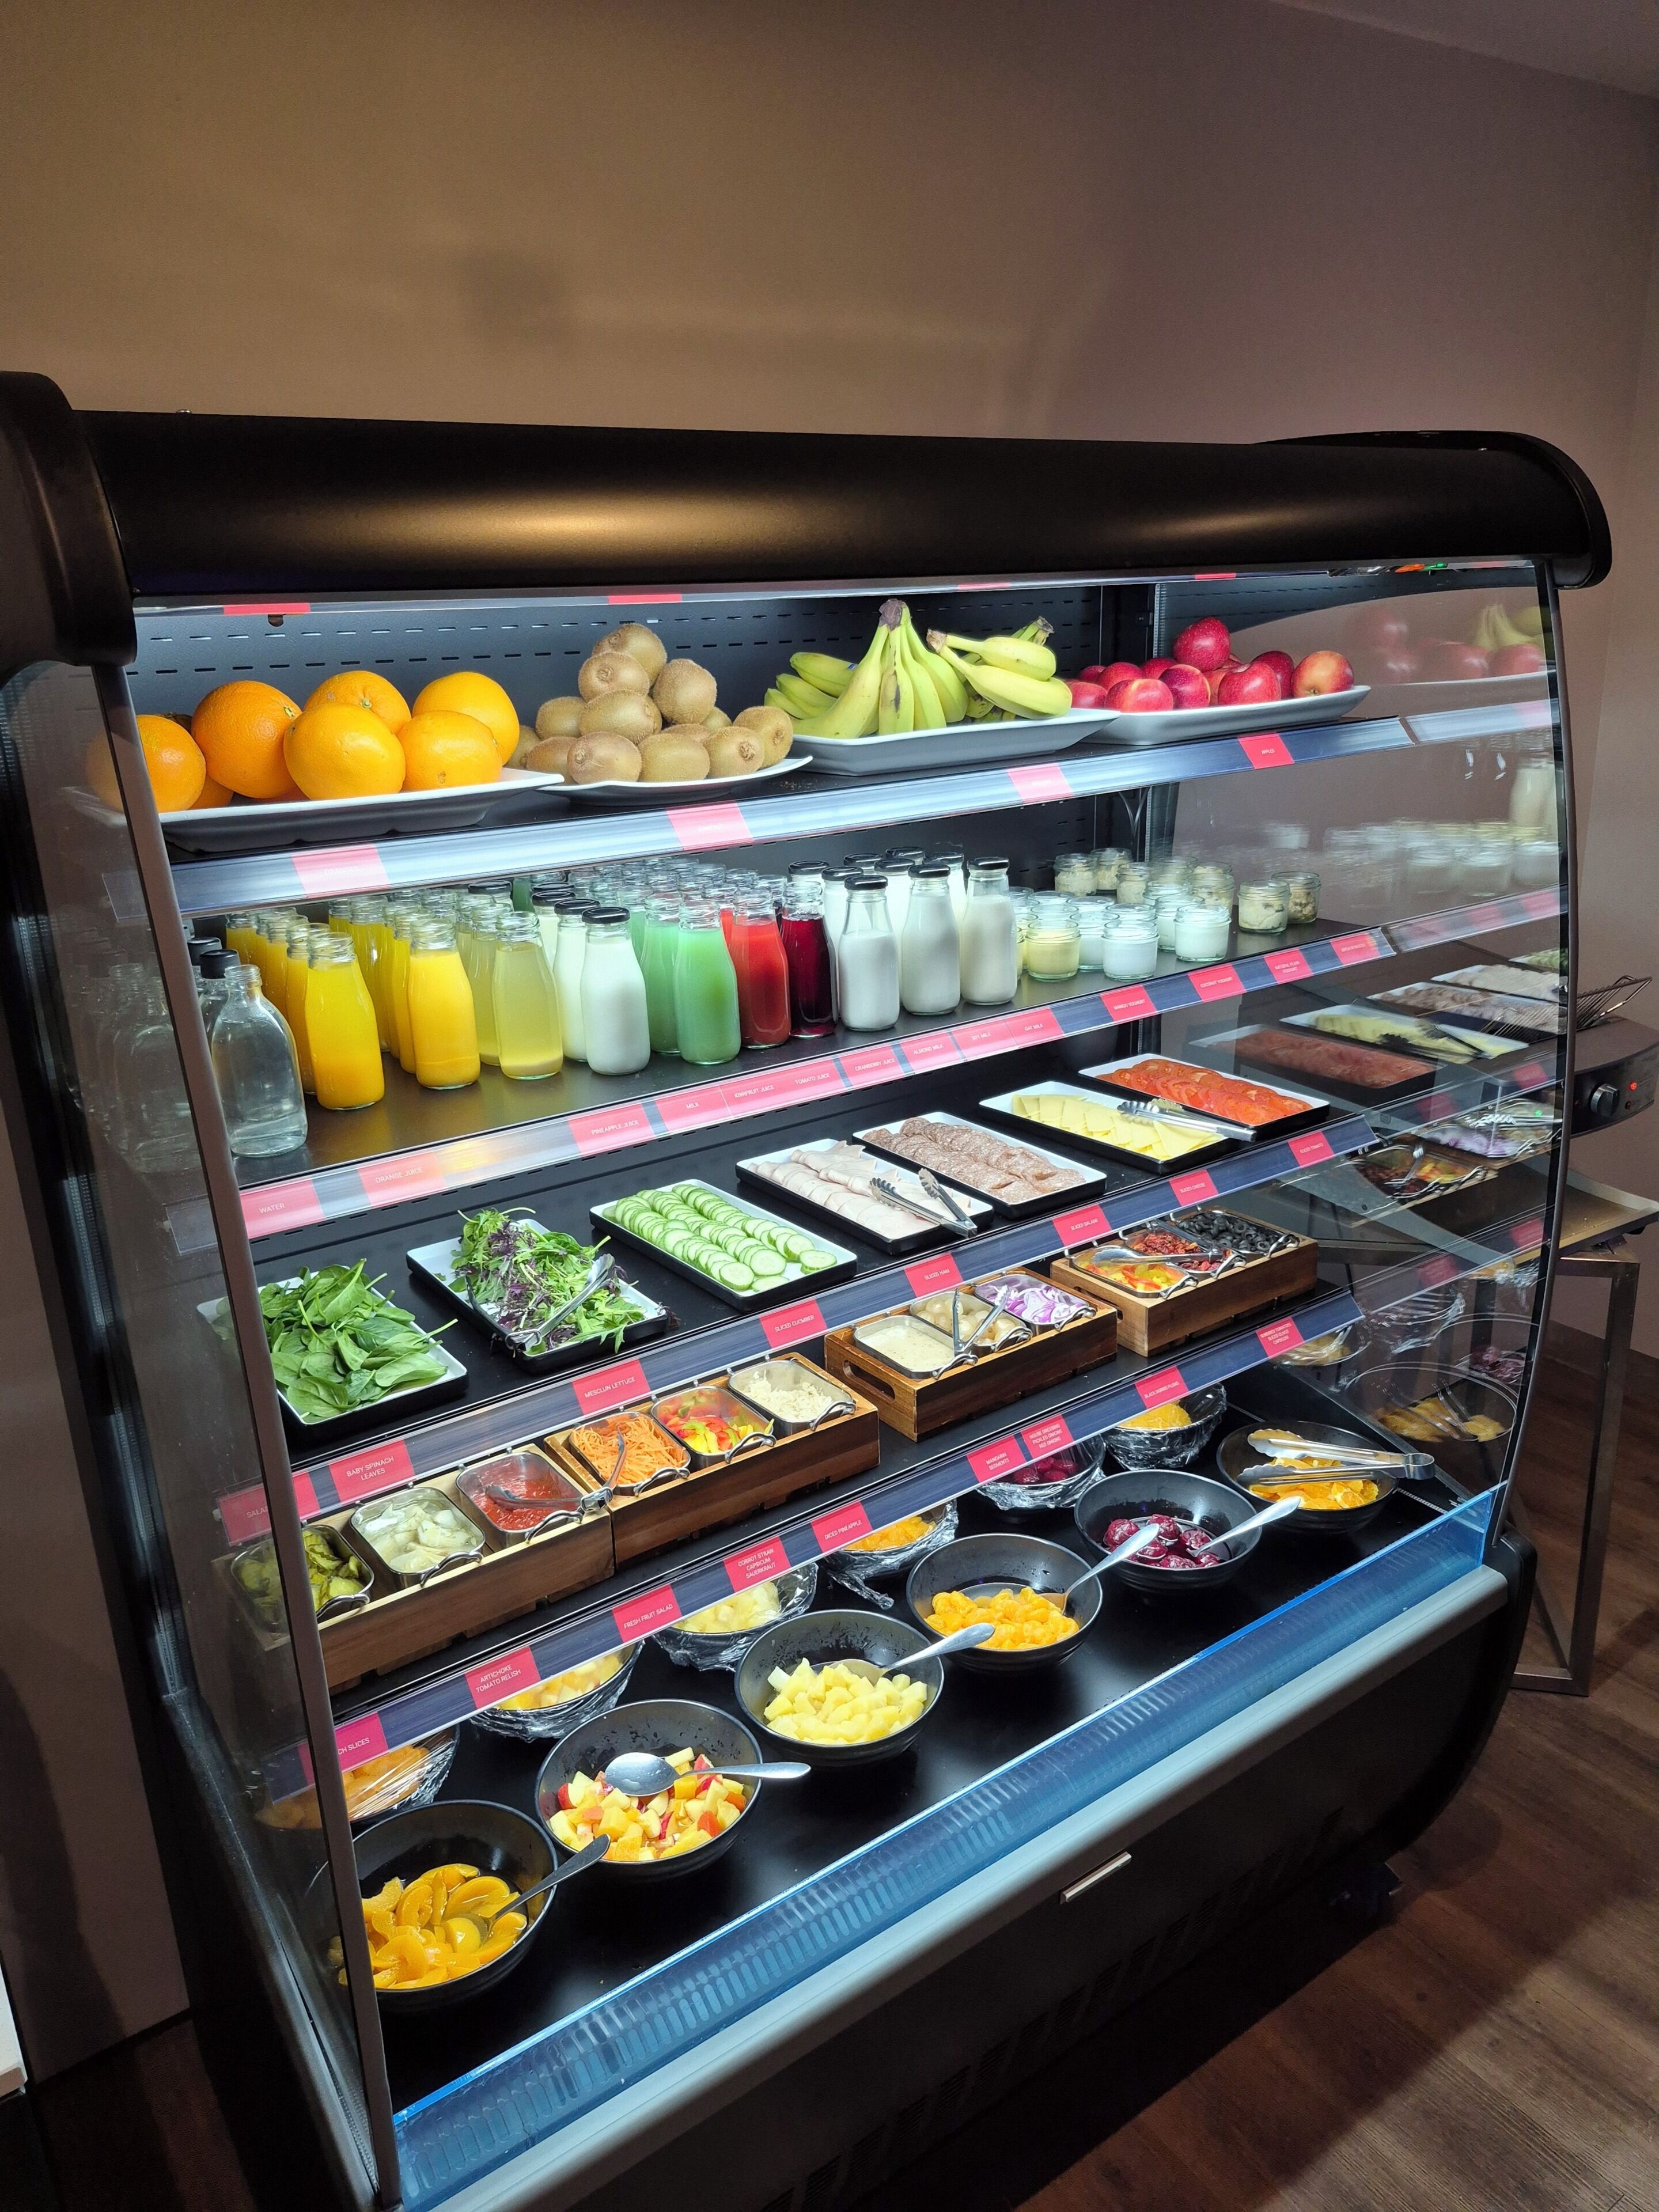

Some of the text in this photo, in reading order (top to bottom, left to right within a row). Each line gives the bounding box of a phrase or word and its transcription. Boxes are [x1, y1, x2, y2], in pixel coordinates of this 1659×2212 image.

[914, 1047, 931, 1055] ALMOND
[855, 1061, 881, 1071] CRANBERRY
[795, 1076, 816, 1085] TOMATO
[734, 1088, 759, 1098] KIWIFRUIT
[591, 1120, 639, 1135] PINEAPPLE JUICE
[376, 1167, 423, 1183] ORANGE JUICE
[259, 1203, 285, 1214] WATER
[924, 1271, 940, 1280] SLICED
[775, 1322, 791, 1332] SLICED
[585, 1376, 636, 1398] MESCLUN LETTUCE
[986, 1452, 1007, 1464] MANDARIN
[988, 1458, 1010, 1470] SEGMENTS
[347, 1456, 395, 1478] BABY SPINACH
[361, 1468, 385, 1481] LEAVES
[824, 1520, 862, 1540] DICED PINEAPPLE
[757, 1548, 774, 1559] STRAW
[746, 1562, 776, 1578] SAUERKRAUT
[747, 1557, 771, 1571] CAPSICUM
[624, 1604, 673, 1629] FRESH FRUIT SALAD
[480, 1664, 513, 1683] ARTICHOKE
[476, 1669, 521, 1693] TOMATO RELISH
[348, 1737, 370, 1751] SLICES
